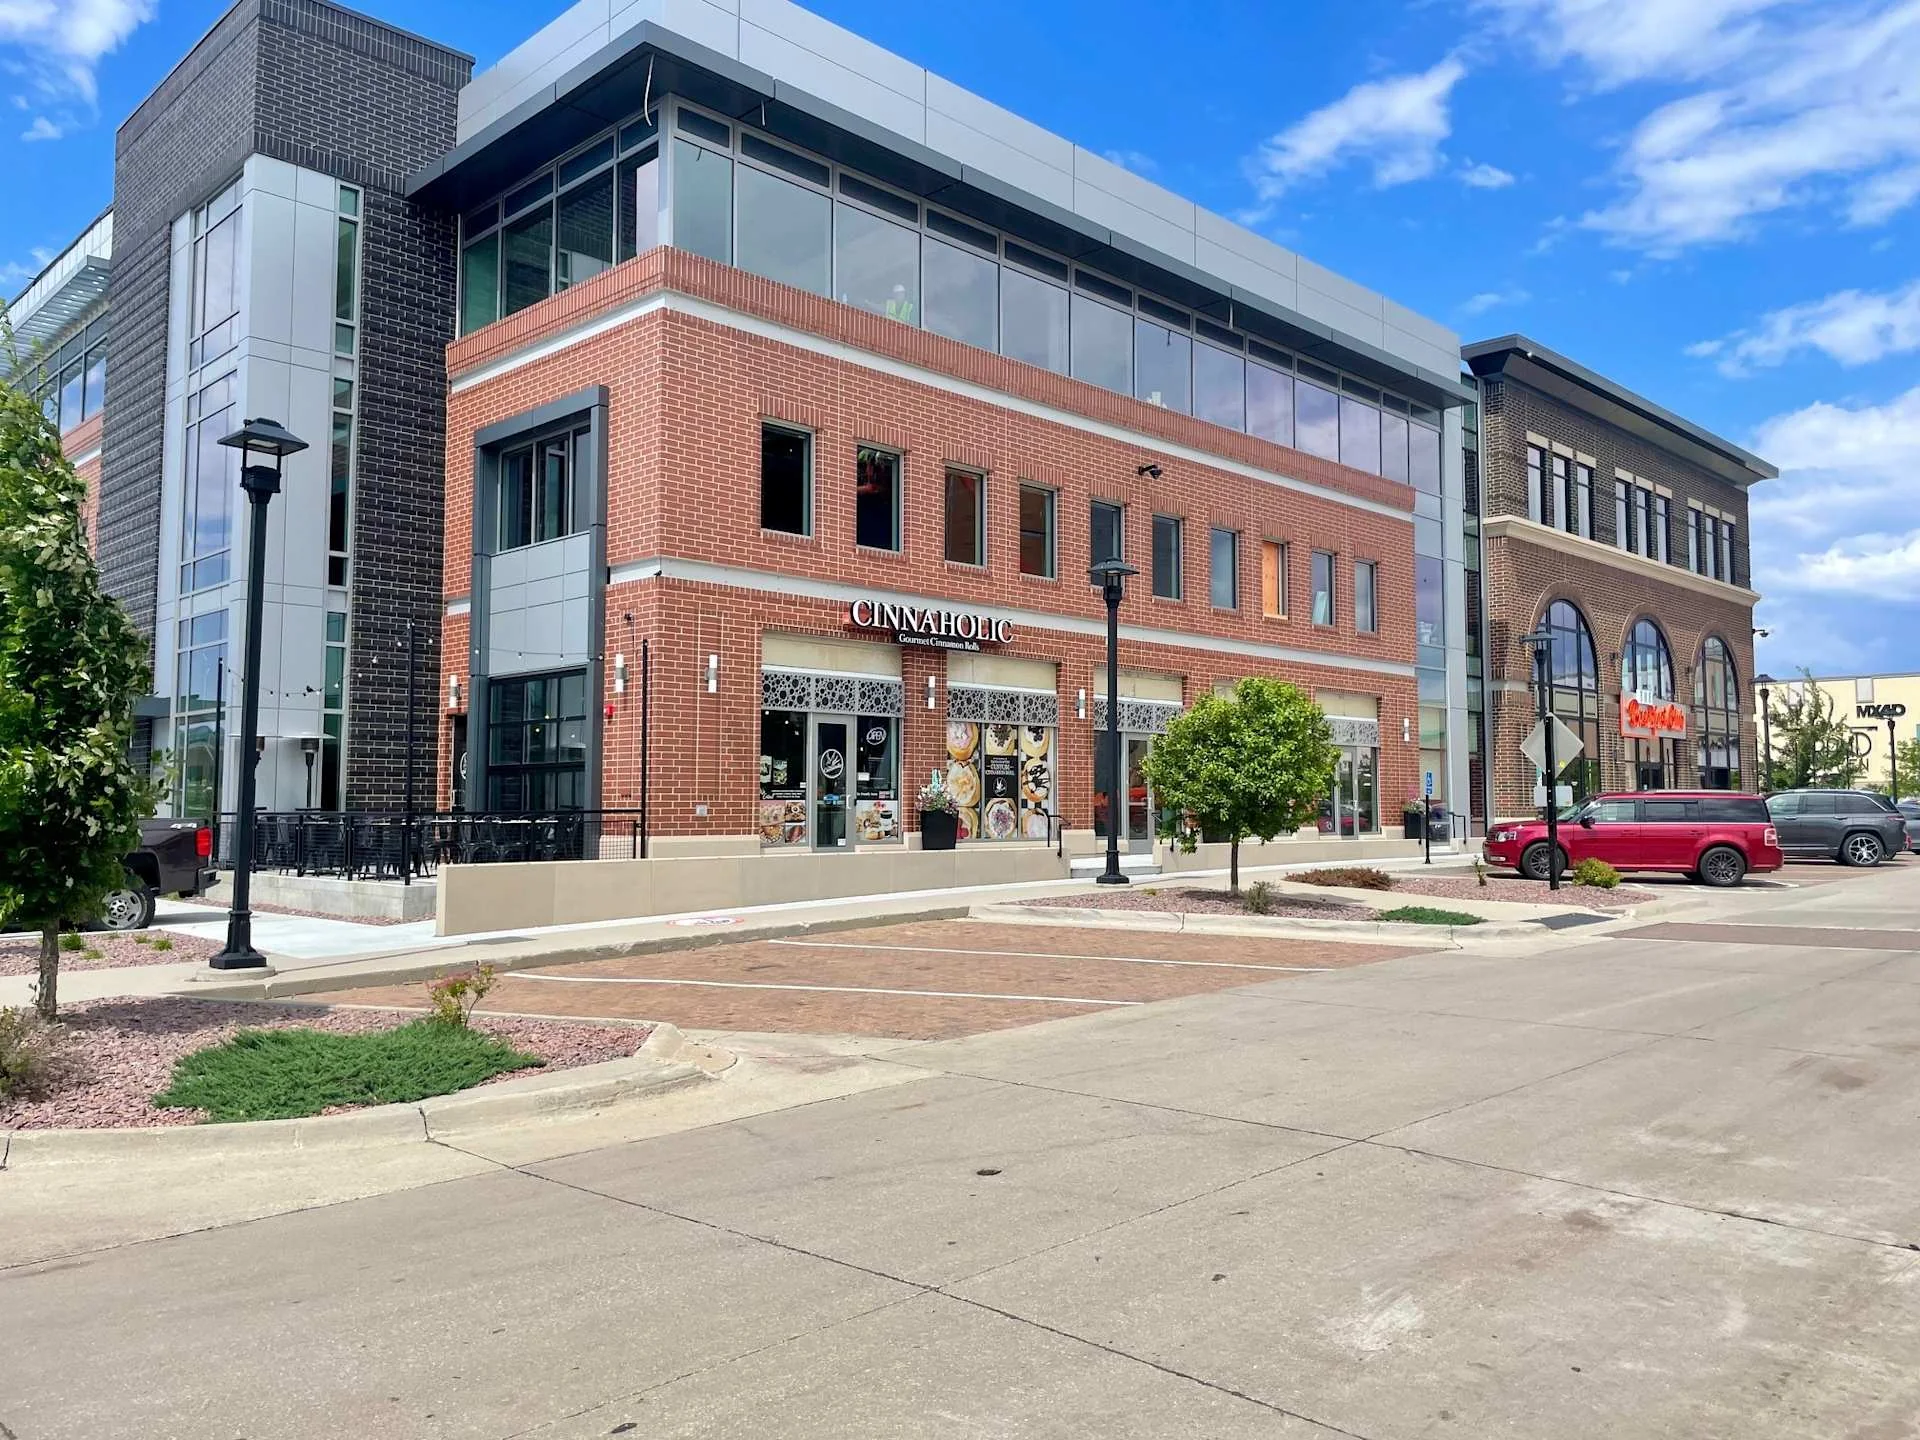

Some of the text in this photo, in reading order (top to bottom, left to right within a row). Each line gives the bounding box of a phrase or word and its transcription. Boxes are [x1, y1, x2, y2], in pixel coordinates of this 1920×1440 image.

[852, 600, 1014, 643] CINNAHOLIC
[899, 634, 980, 651] Gourmet Cinnamon Rolls
